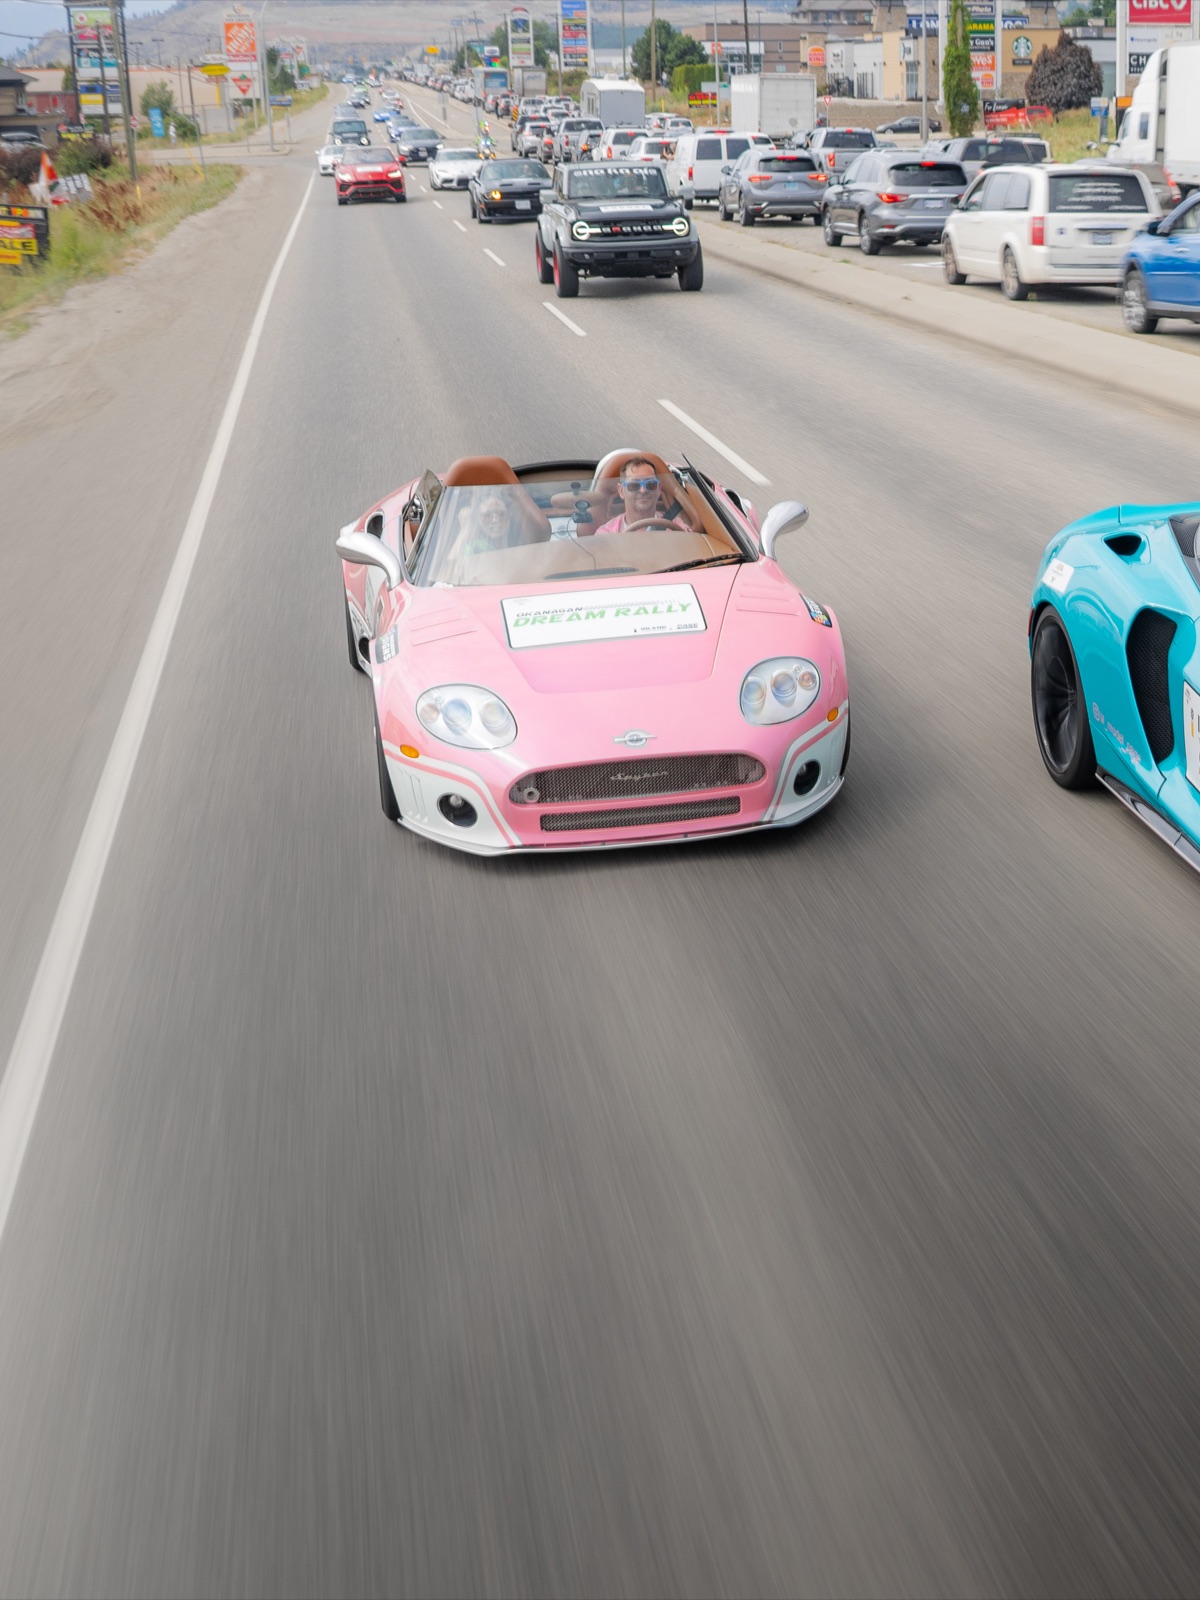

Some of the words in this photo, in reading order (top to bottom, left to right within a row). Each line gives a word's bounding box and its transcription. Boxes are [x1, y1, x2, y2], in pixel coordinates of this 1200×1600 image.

[0, 240, 34, 252] ALE
[513, 609, 606, 627] DREAM
[614, 602, 692, 617] RALLY
[516, 606, 583, 617] OKANAGAN
